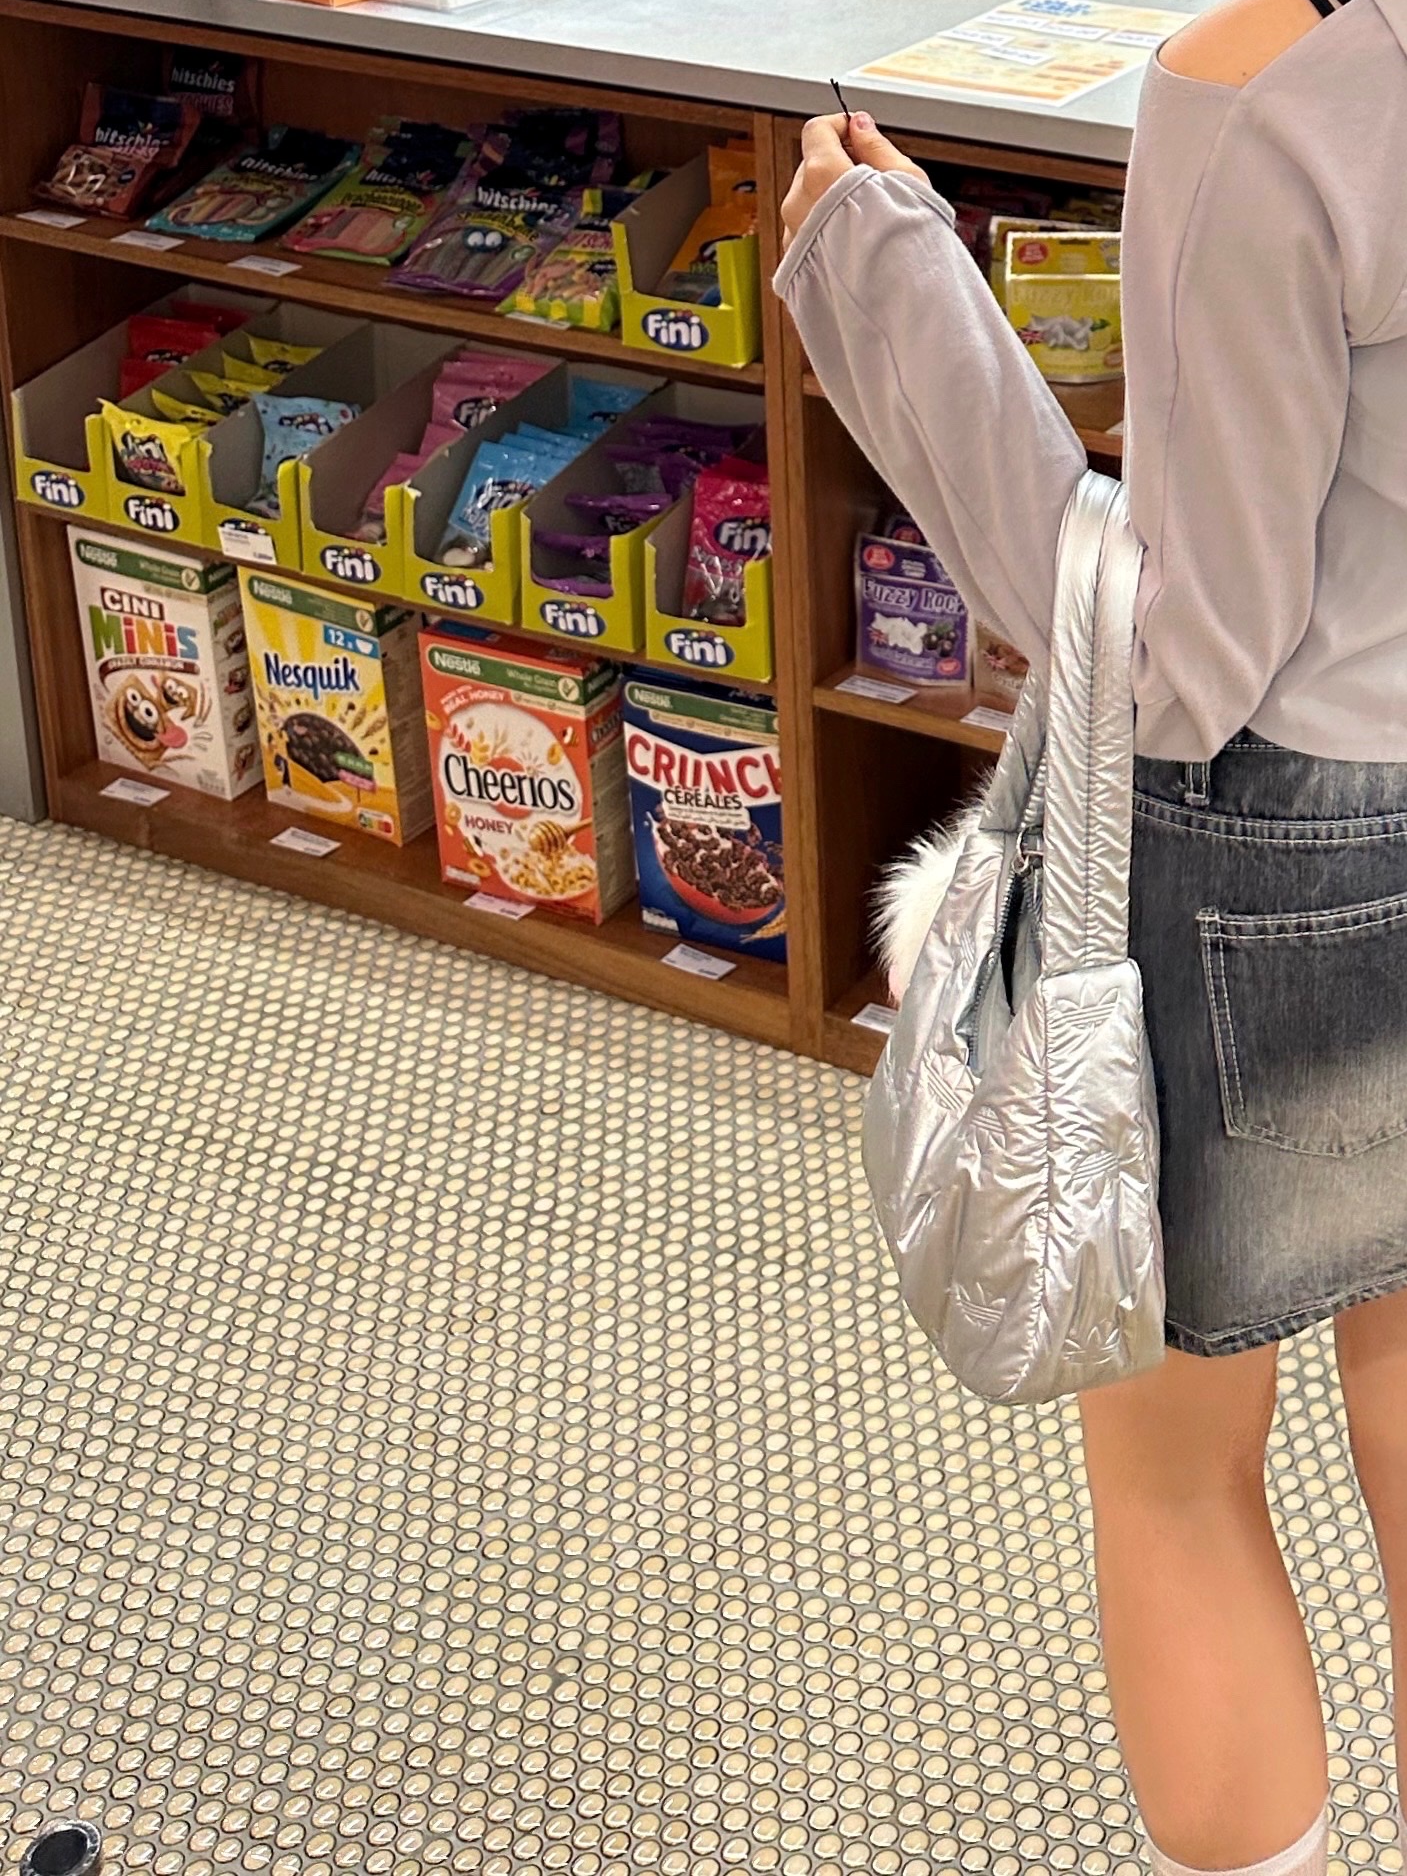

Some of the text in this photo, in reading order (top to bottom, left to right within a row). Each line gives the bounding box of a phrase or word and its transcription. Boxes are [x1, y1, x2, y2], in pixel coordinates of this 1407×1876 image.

[645, 314, 703, 350] Fini
[34, 474, 80, 507] Fini
[127, 498, 175, 531] Fini
[719, 519, 772, 552] Fin
[324, 549, 376, 583] Fini
[103, 589, 162, 620] CINI
[423, 575, 478, 608] Fini
[544, 603, 600, 637] Fini
[328, 628, 345, 647] 12
[670, 632, 727, 666] Fini
[263, 651, 361, 701] Nesquik
[443, 752, 576, 812] Cheerios
[464, 813, 514, 835] HONEY
